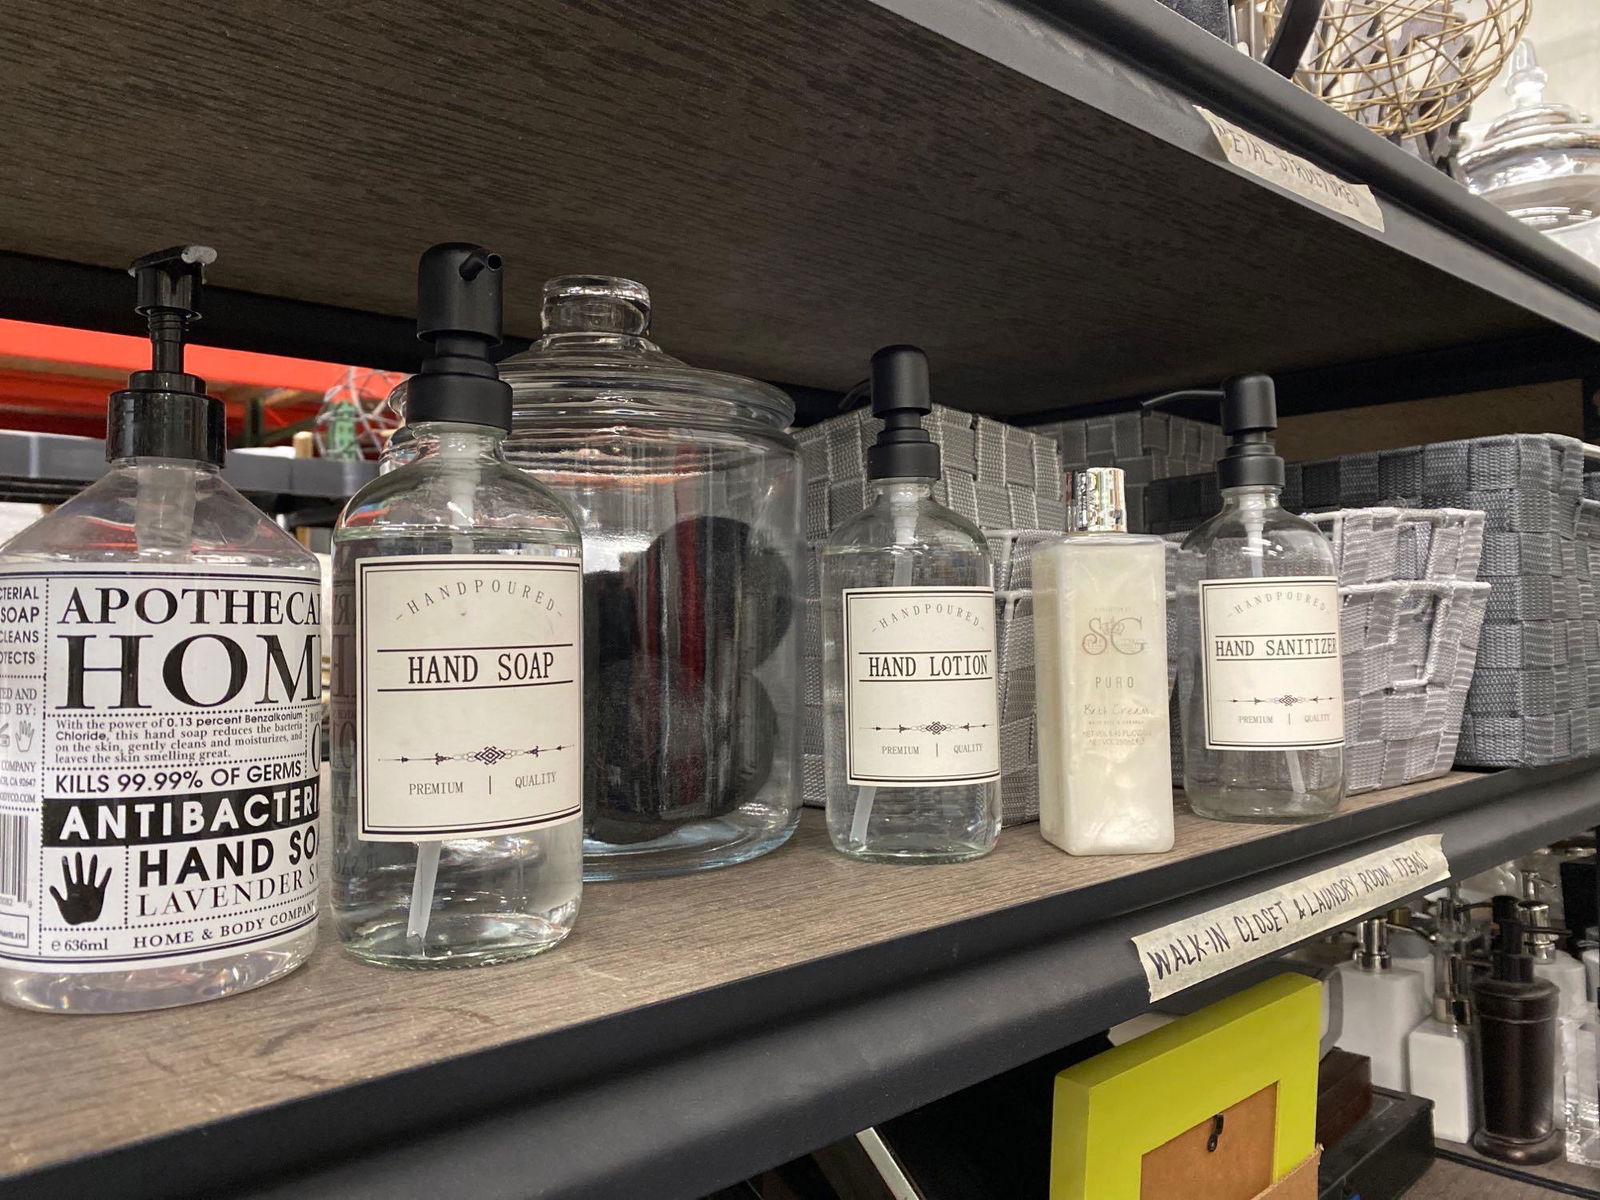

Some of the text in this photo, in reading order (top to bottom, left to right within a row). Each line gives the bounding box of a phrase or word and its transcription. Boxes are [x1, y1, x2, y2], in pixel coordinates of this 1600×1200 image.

[0, 606, 40, 623] SOAP
[1215, 637, 1337, 657] HAND SANITIZER
[55, 633, 321, 709] HOM
[408, 651, 554, 684] HAND SOAP
[868, 654, 988, 677] HAND LOTION
[15, 687, 38, 700] AND
[16, 703, 37, 716] BY:
[1238, 713, 1330, 724] PREMIUM QUALITY
[56, 719, 83, 730] With
[86, 718, 106, 730] the
[109, 718, 148, 732] power
[151, 716, 165, 728] of
[166, 715, 192, 728] 0.13
[196, 714, 242, 728] percent
[245, 711, 303, 724] Benzalkonium
[56, 721, 303, 742] Chloride, this hand soap reduces the bacteria
[55, 743, 70, 752] on
[74, 741, 91, 752] the
[128, 740, 167, 754] gently
[170, 739, 207, 750] cleans
[210, 738, 231, 748] and
[234, 734, 290, 747] moisturizes,
[290, 731, 303, 741] and
[881, 744, 983, 755] PREMIUM QUALITY
[55, 749, 231, 764] leaves the skin smelling great.
[55, 760, 302, 793] KILLS 99.99% OF GERMS
[408, 771, 557, 796] PREMIUM QUALITY
[138, 825, 321, 888] HAND SO
[136, 870, 303, 917] LAVENDER
[1147, 850, 1430, 980] WALK-IN CLOSET & LAUNDRY ROOM ITEMS
[133, 931, 194, 948] HOME
[201, 928, 213, 940] &
[220, 917, 264, 937] BODY
[64, 938, 109, 951] 636ml
